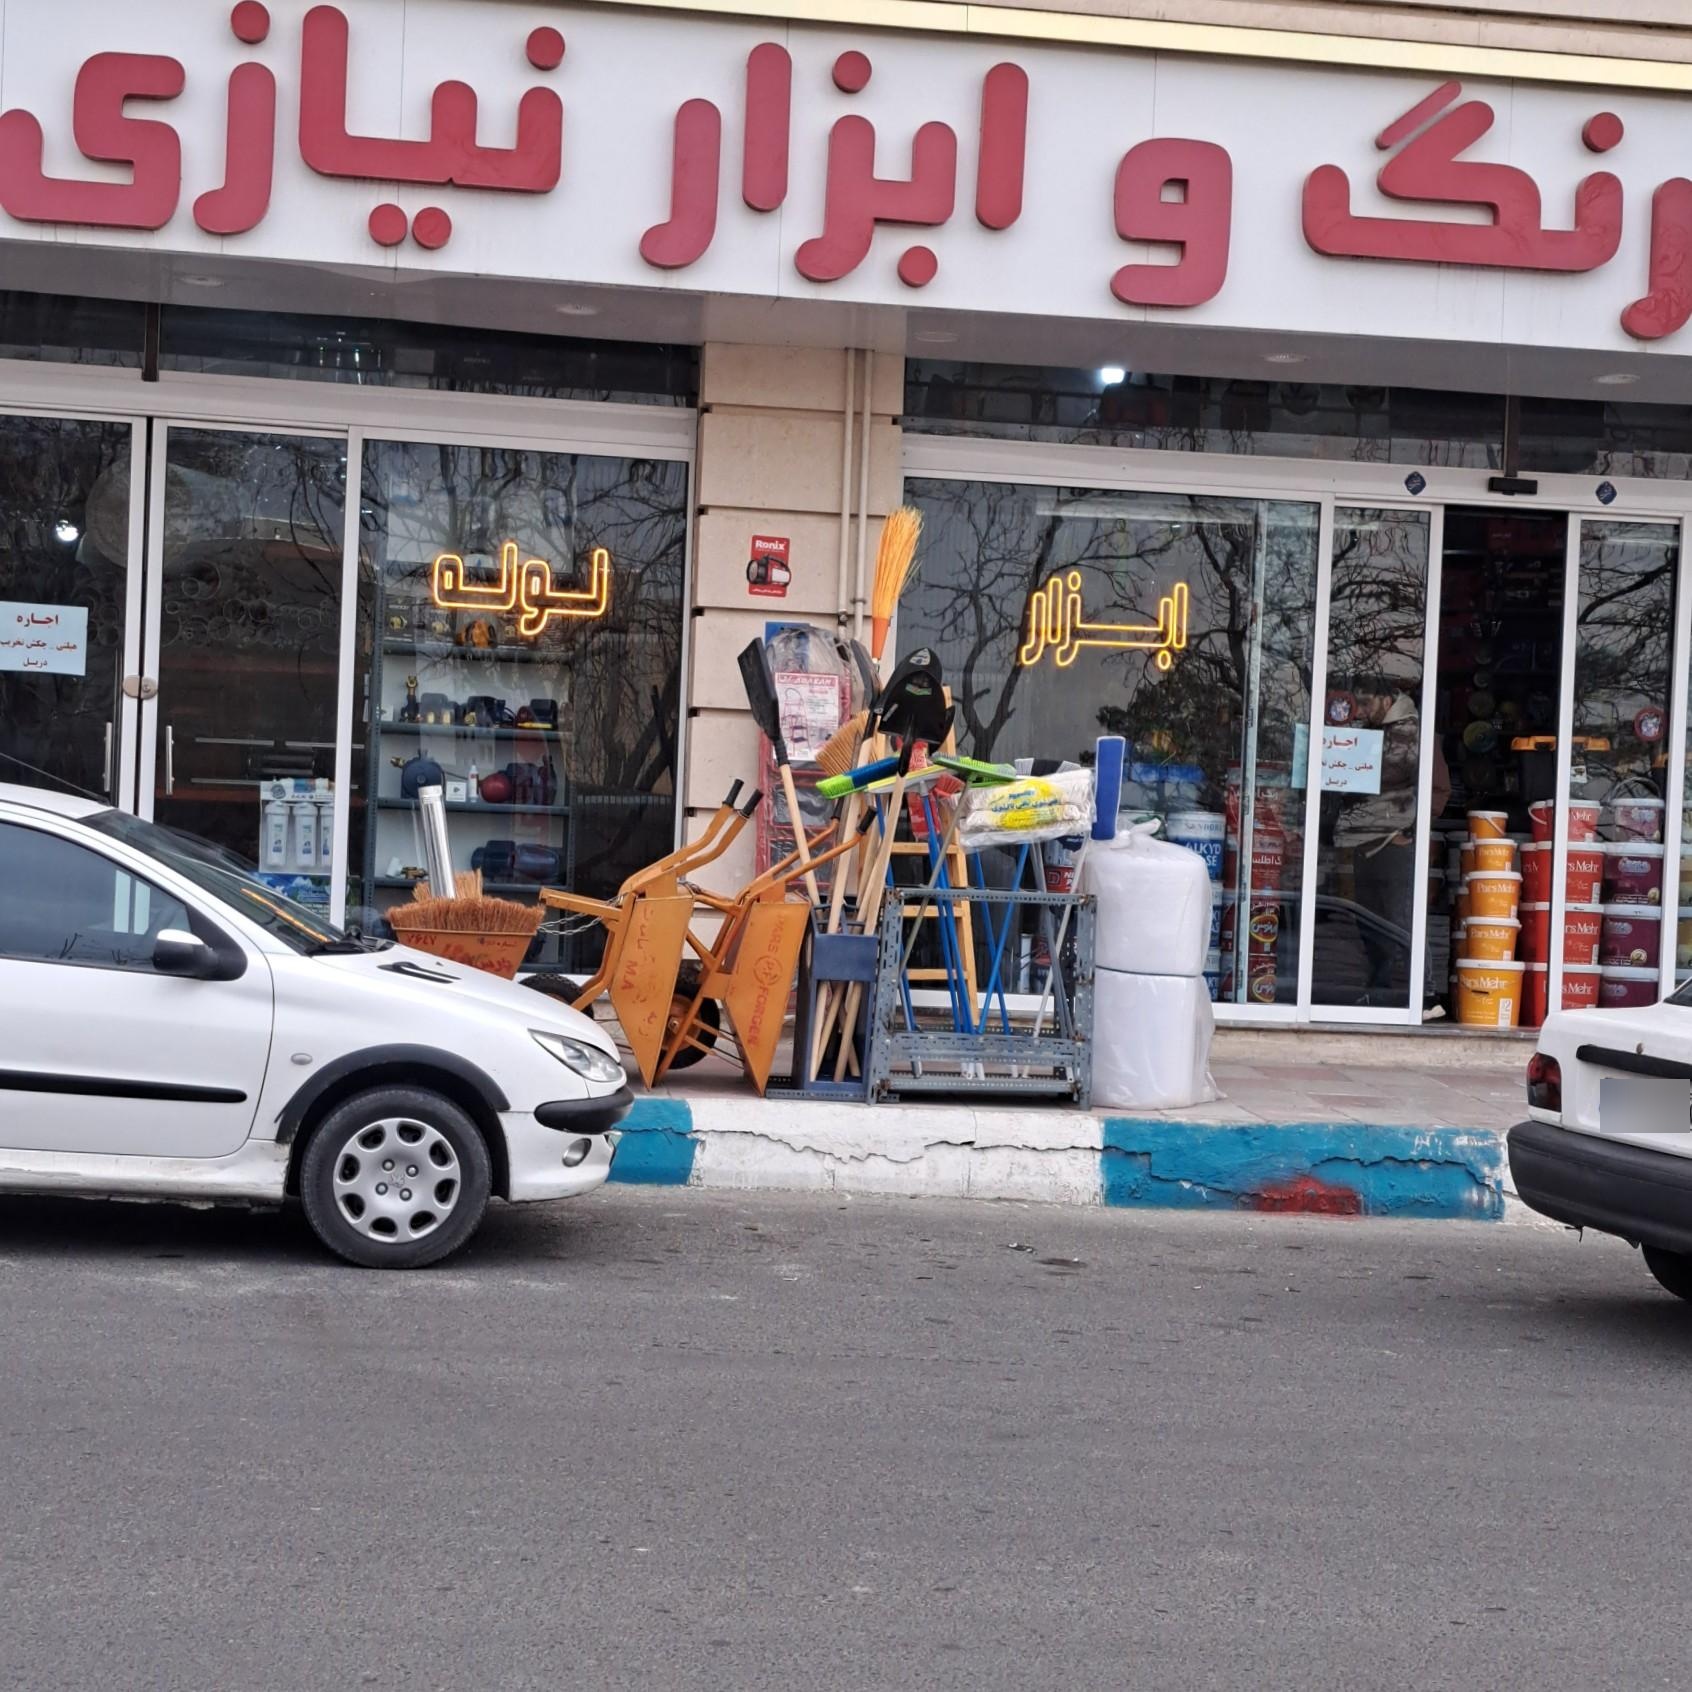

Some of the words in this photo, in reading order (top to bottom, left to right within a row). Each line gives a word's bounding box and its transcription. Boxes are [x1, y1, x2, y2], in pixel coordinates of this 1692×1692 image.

[0, 0, 564, 250] نیازی
[640, 43, 1028, 288] ابزار
[1110, 137, 1232, 308] و
[1302, 81, 1692, 340] رنگ
[431, 539, 610, 637] لوله
[755, 540, 785, 550] Ronix
[16, 612, 59, 628] اجاره
[1020, 571, 1190, 671] ابزار
[1577, 922, 1599, 935] Mehr
[1568, 981, 1593, 995] Mehr
